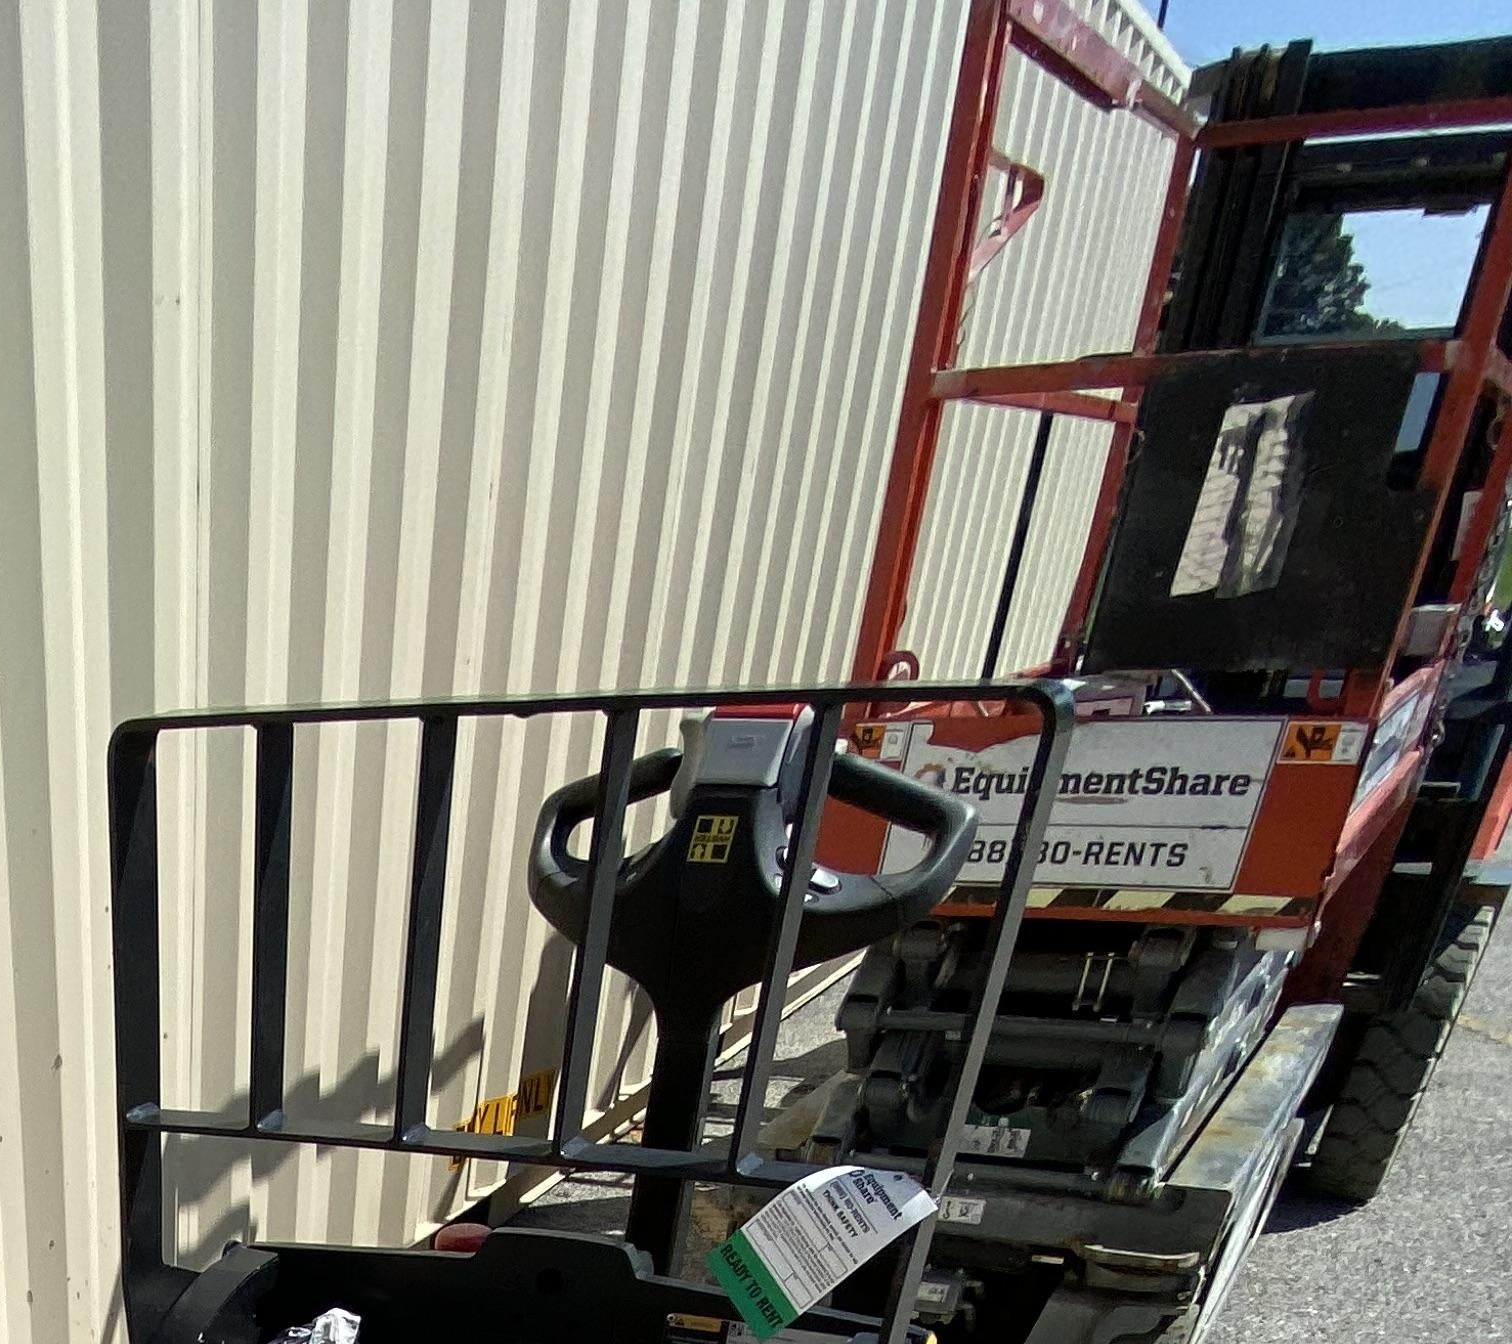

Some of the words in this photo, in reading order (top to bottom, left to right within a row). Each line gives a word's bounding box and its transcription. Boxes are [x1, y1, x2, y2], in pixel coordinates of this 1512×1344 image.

[951, 766, 1251, 801] EquimentShare
[863, 1173, 903, 1221] Equipment
[720, 1243, 753, 1282] READY
[746, 1279, 763, 1299] TO
[755, 1295, 785, 1329] RENT
